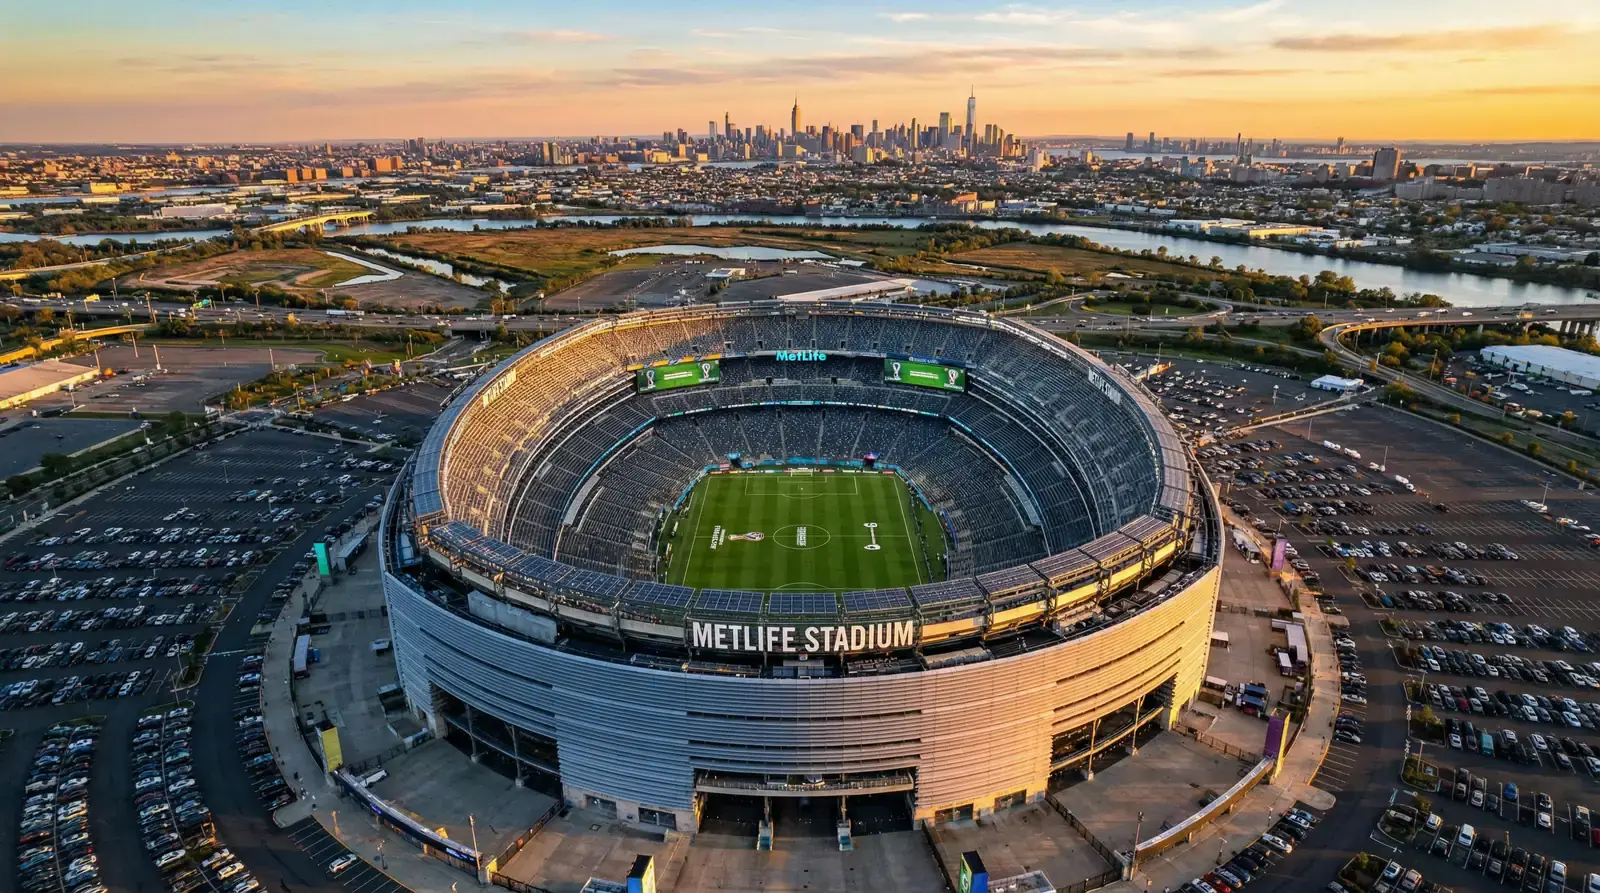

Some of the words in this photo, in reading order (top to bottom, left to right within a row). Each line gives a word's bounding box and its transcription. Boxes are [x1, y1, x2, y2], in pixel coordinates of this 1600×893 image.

[776, 350, 827, 361] MetLife
[692, 622, 796, 652] METLIFE
[805, 620, 914, 652] STADIUM
